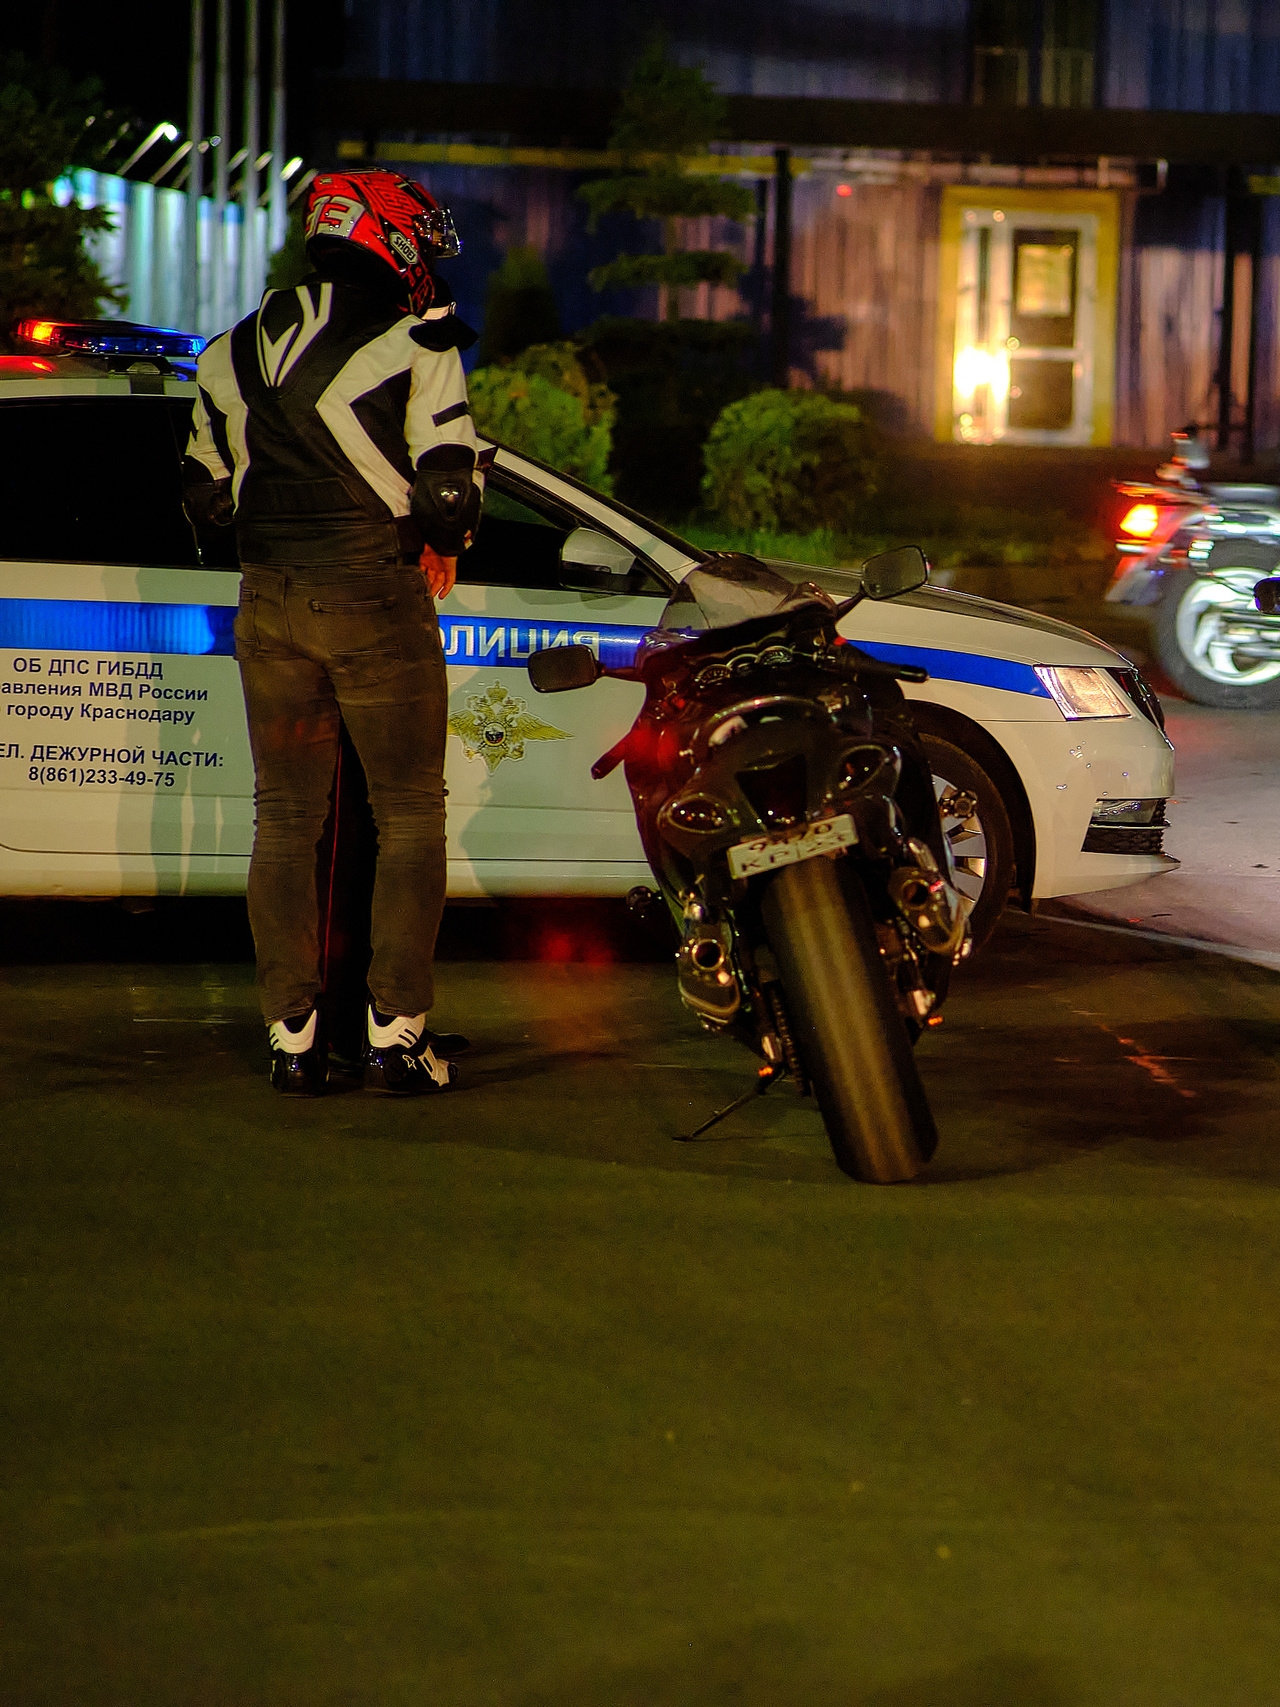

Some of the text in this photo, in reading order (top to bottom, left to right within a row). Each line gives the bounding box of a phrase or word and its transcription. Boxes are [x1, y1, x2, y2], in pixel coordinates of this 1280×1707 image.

[393, 236, 418, 260] SHOEI
[13, 657, 163, 680] ОБ ДПС ГИБДД
[1, 682, 208, 701] авления МВД России
[7, 703, 195, 725] городу Краснодару
[30, 745, 145, 764] ДЕЖУРНОЙ
[152, 750, 223, 767] ЧАСТИ:
[28, 766, 175, 787] 8(861)233-49-75
